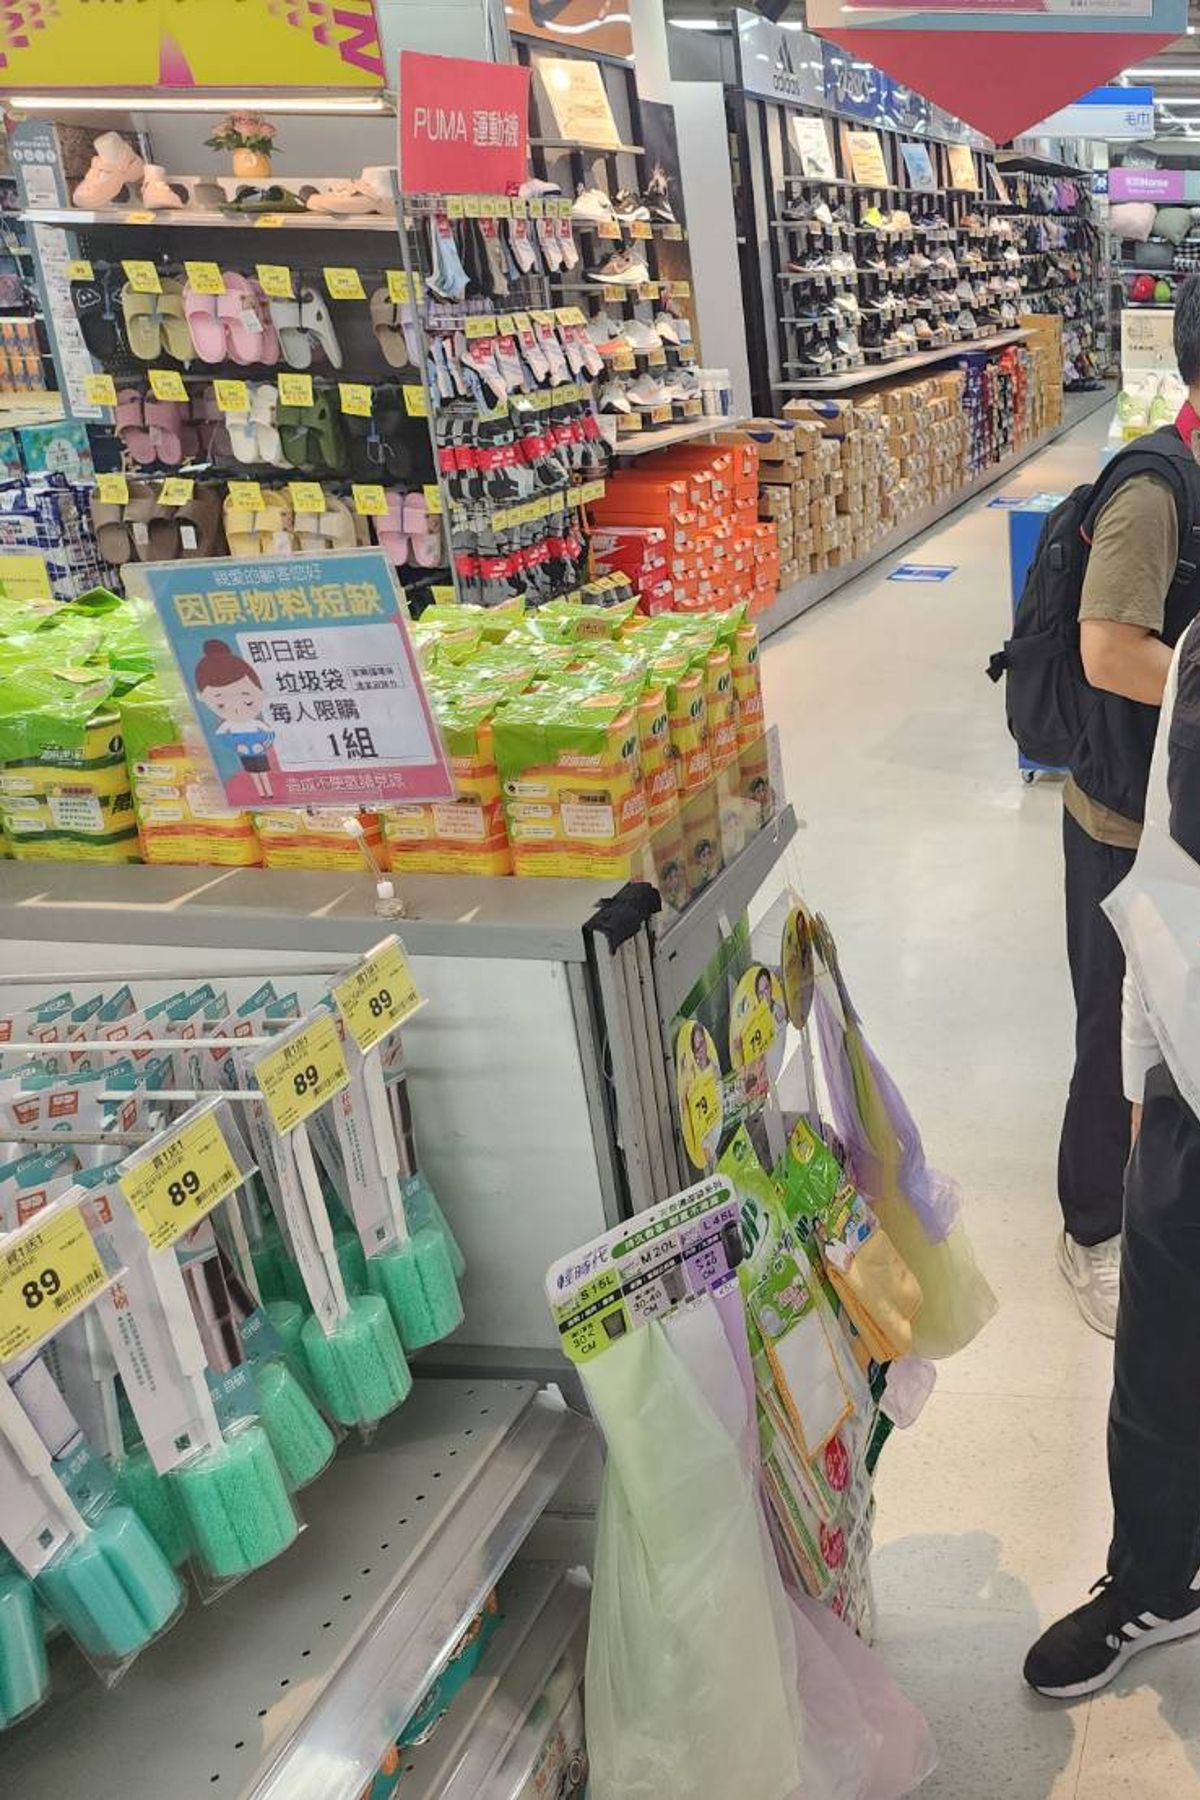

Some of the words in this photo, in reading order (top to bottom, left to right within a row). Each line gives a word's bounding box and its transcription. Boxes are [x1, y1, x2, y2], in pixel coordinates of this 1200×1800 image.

[413, 107, 467, 142] PUMA
[1124, 112, 1150, 126] 毛巾
[248, 637, 318, 664] 即日起
[275, 668, 346, 694] 垃圾袋
[269, 698, 361, 724] 每人限購
[328, 726, 379, 760] 1組
[369, 989, 393, 1017] 89
[293, 1065, 319, 1095] 89
[168, 1170, 200, 1206] 89
[640, 1254, 651, 1265] M
[22, 1268, 61, 1309] 89
